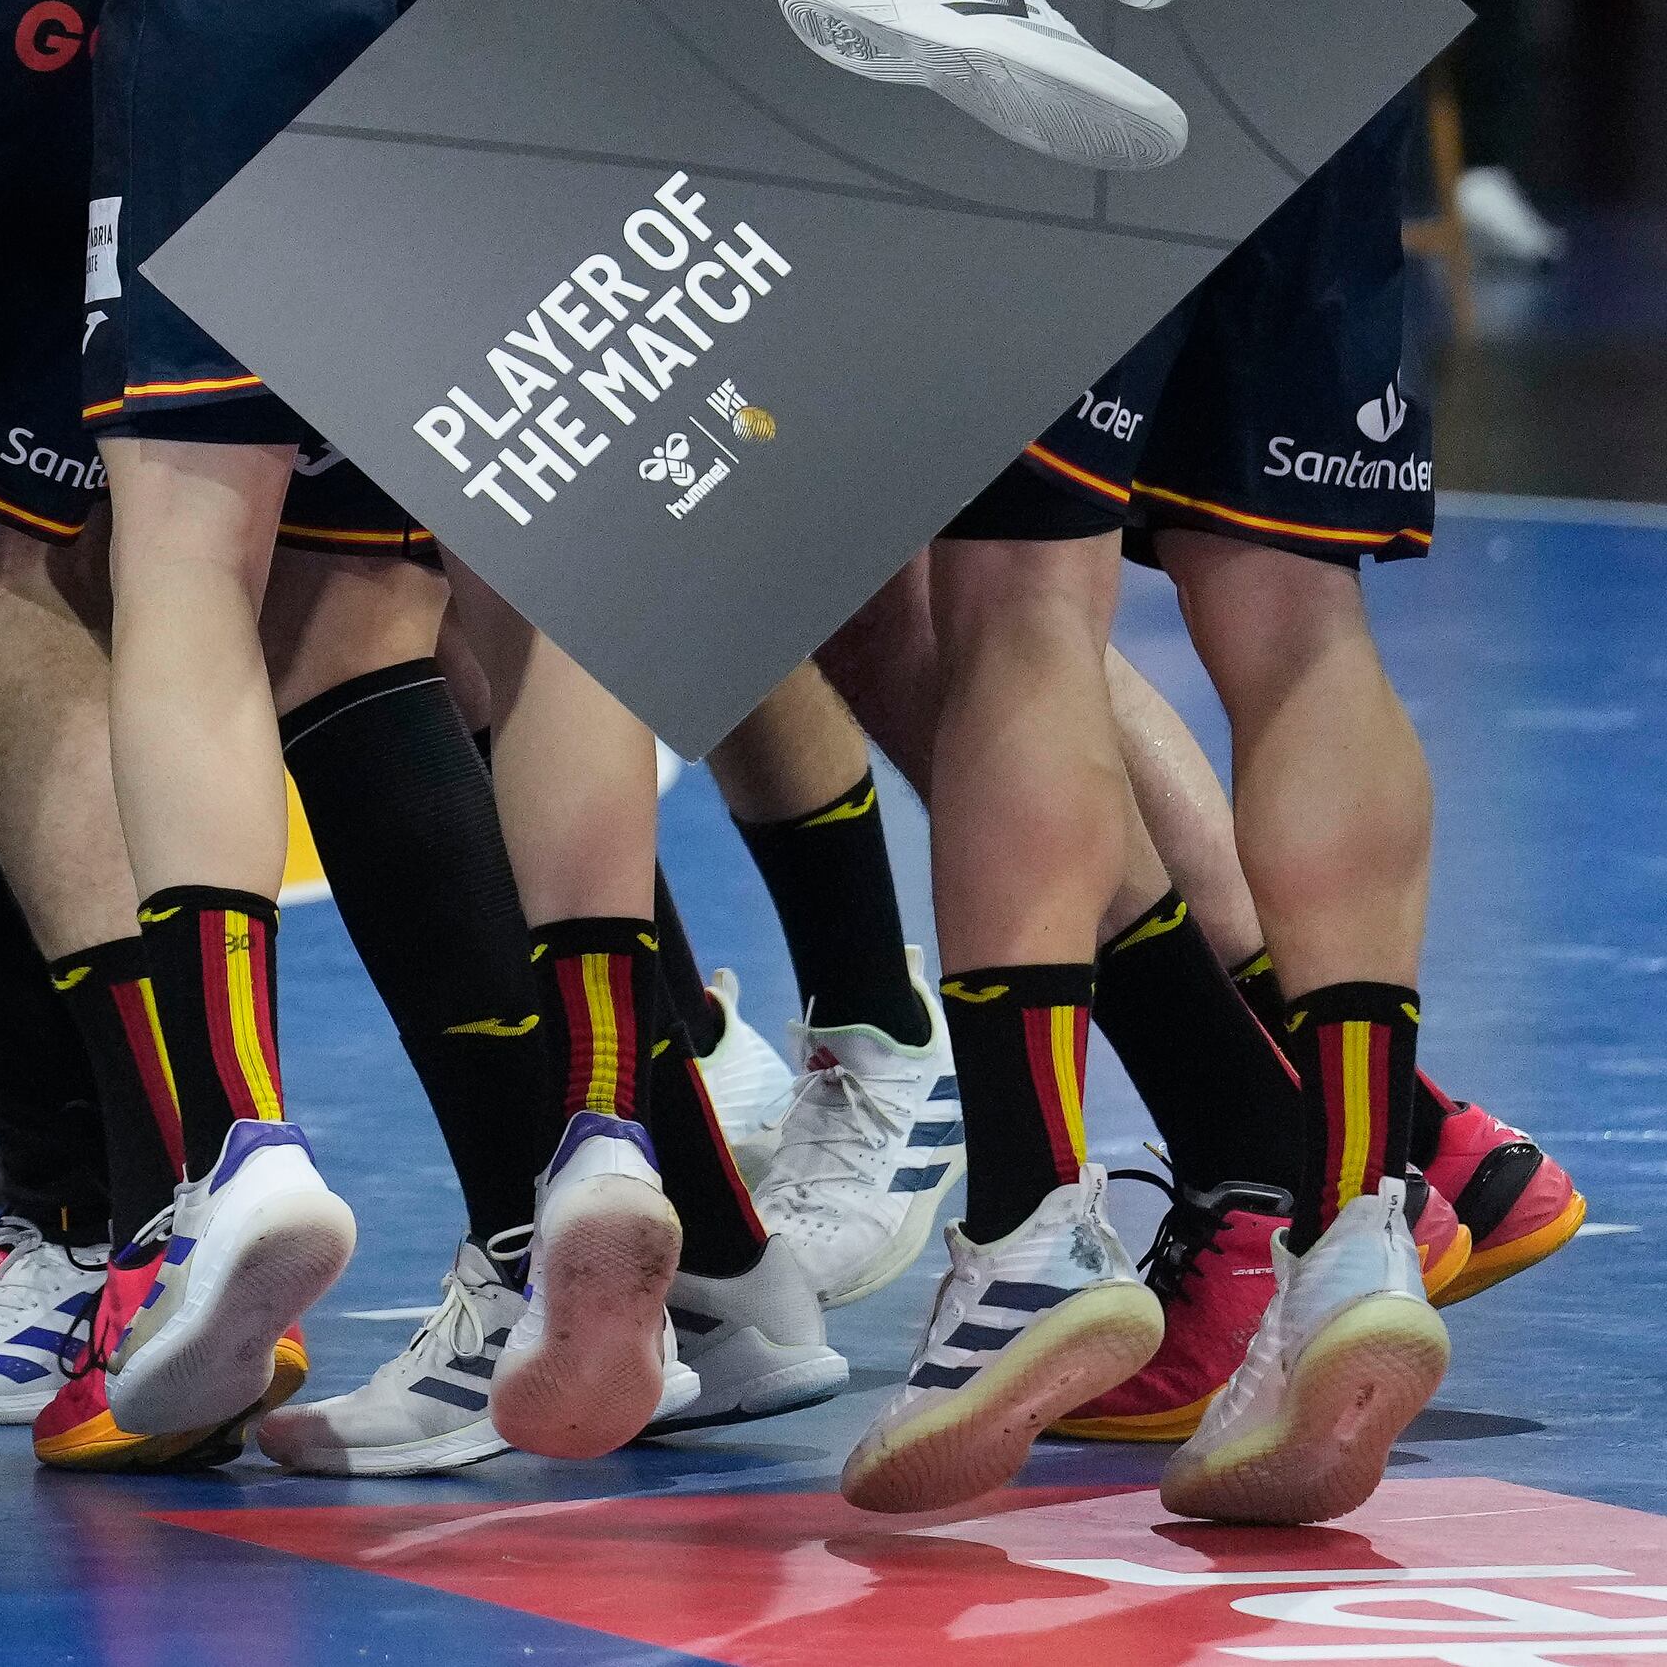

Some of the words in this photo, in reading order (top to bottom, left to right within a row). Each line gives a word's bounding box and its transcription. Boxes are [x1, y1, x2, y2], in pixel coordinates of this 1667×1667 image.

[413, 253, 650, 474] PLAYER
[622, 170, 713, 272] OF
[462, 395, 611, 526] THE
[577, 221, 792, 425] MATCH
[665, 456, 732, 521] hummel
